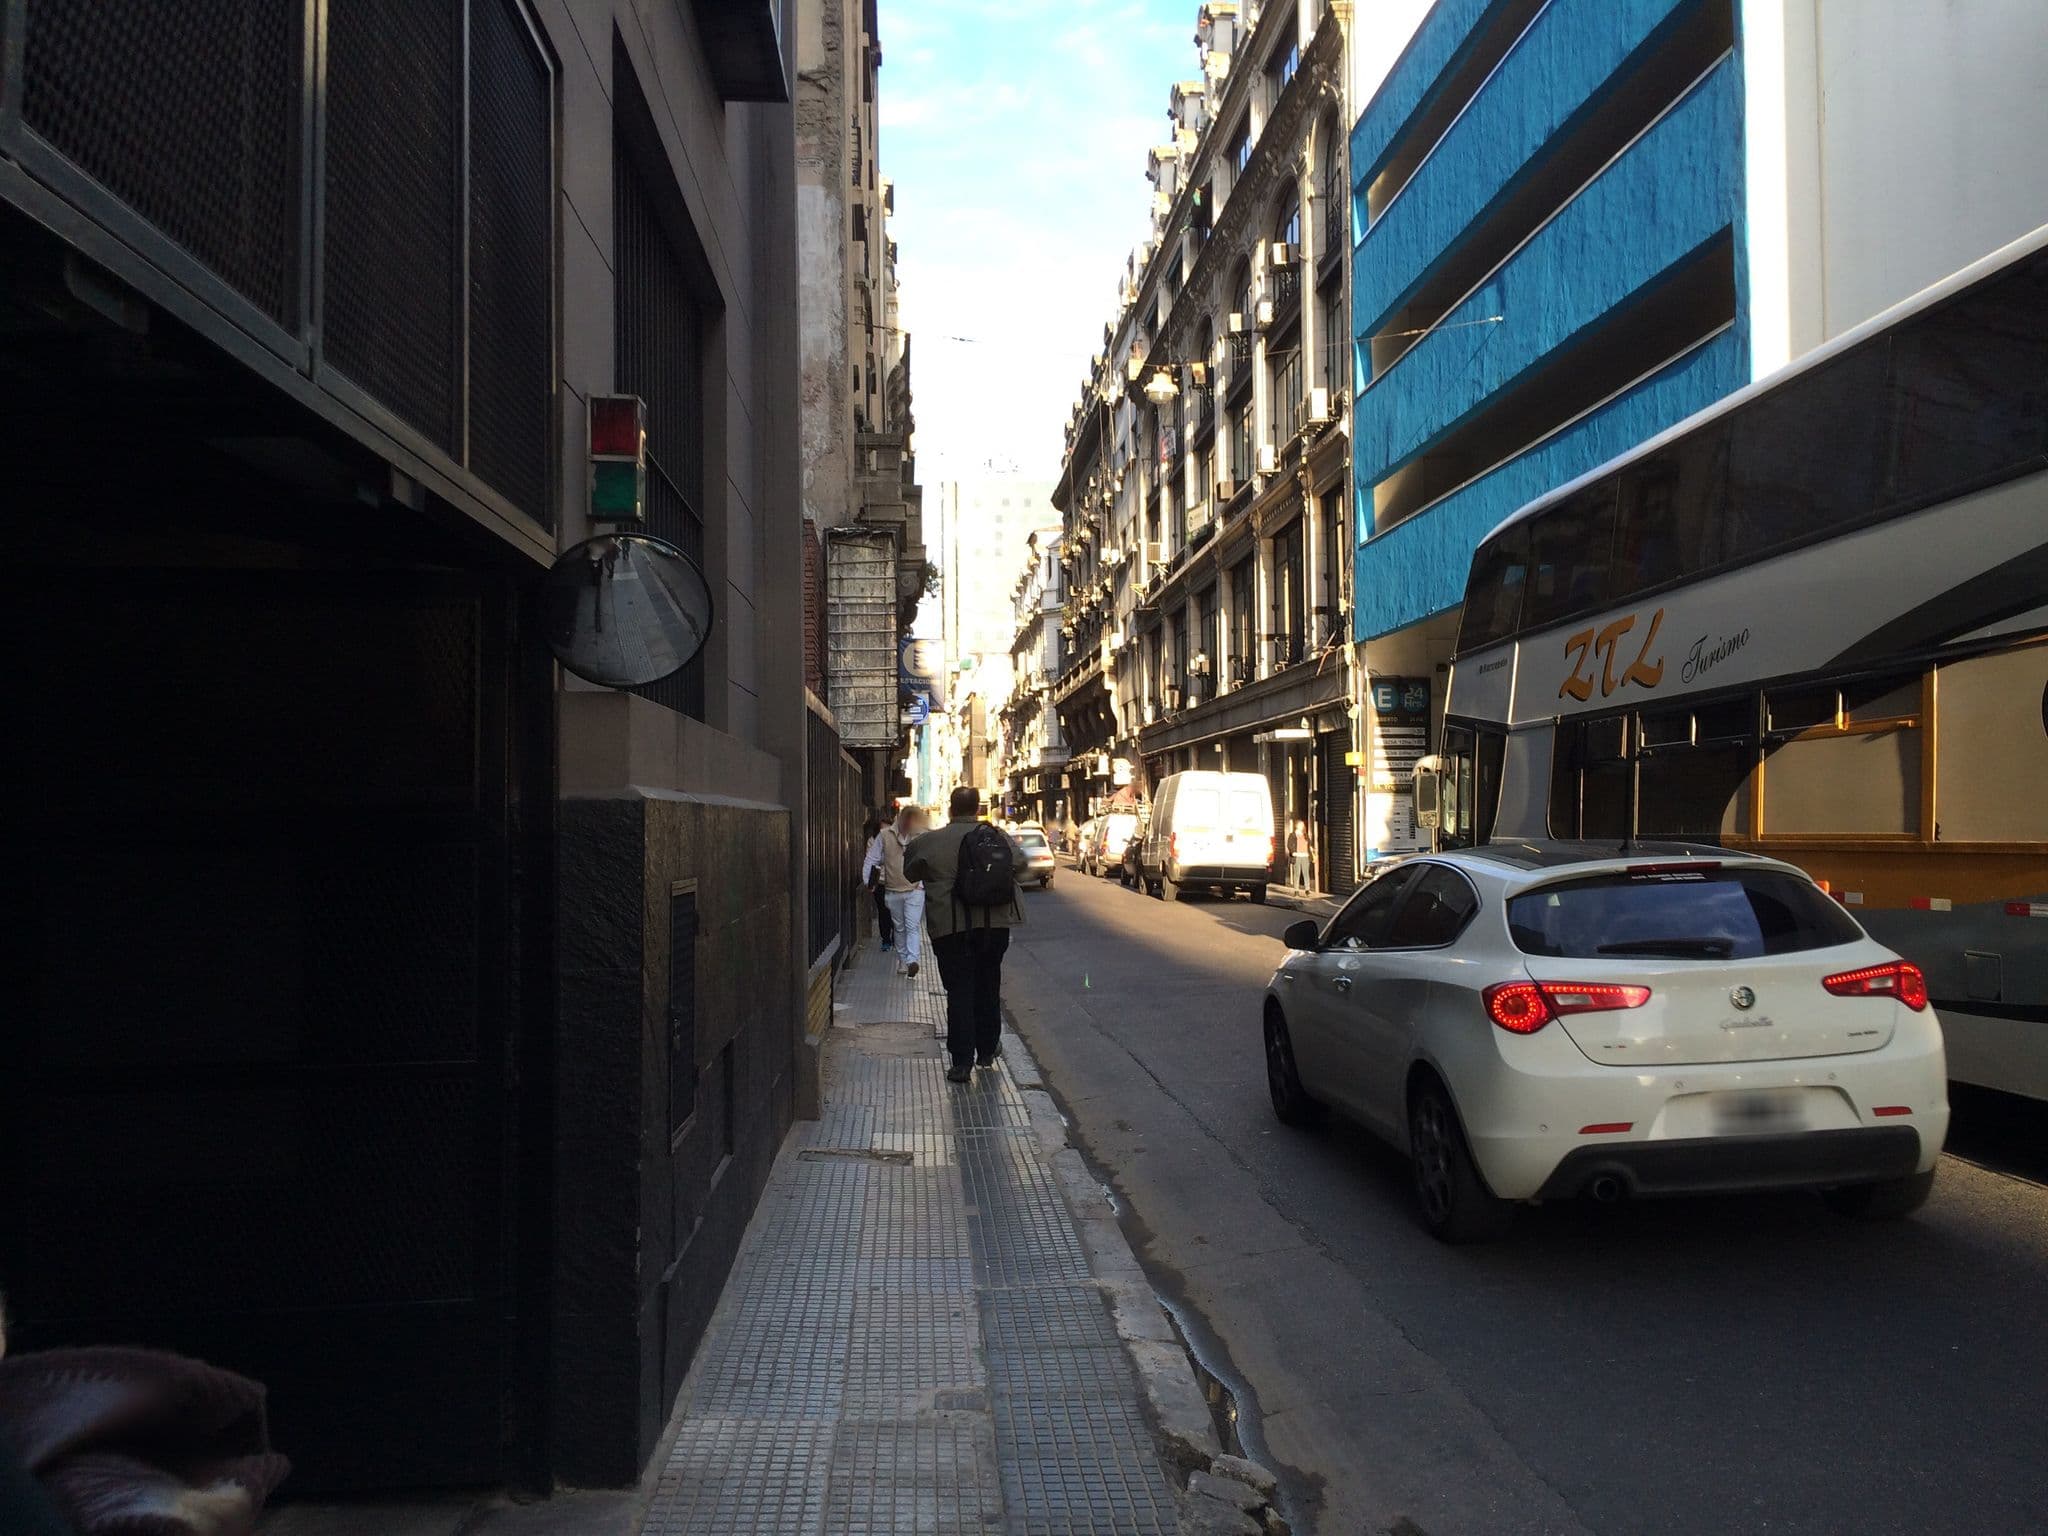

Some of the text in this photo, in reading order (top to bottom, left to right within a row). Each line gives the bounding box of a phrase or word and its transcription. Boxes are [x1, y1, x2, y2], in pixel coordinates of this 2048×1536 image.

[1558, 607, 1750, 702] ZTL Turismo
[1377, 687, 1393, 708] E
[1404, 687, 1424, 699] 24
